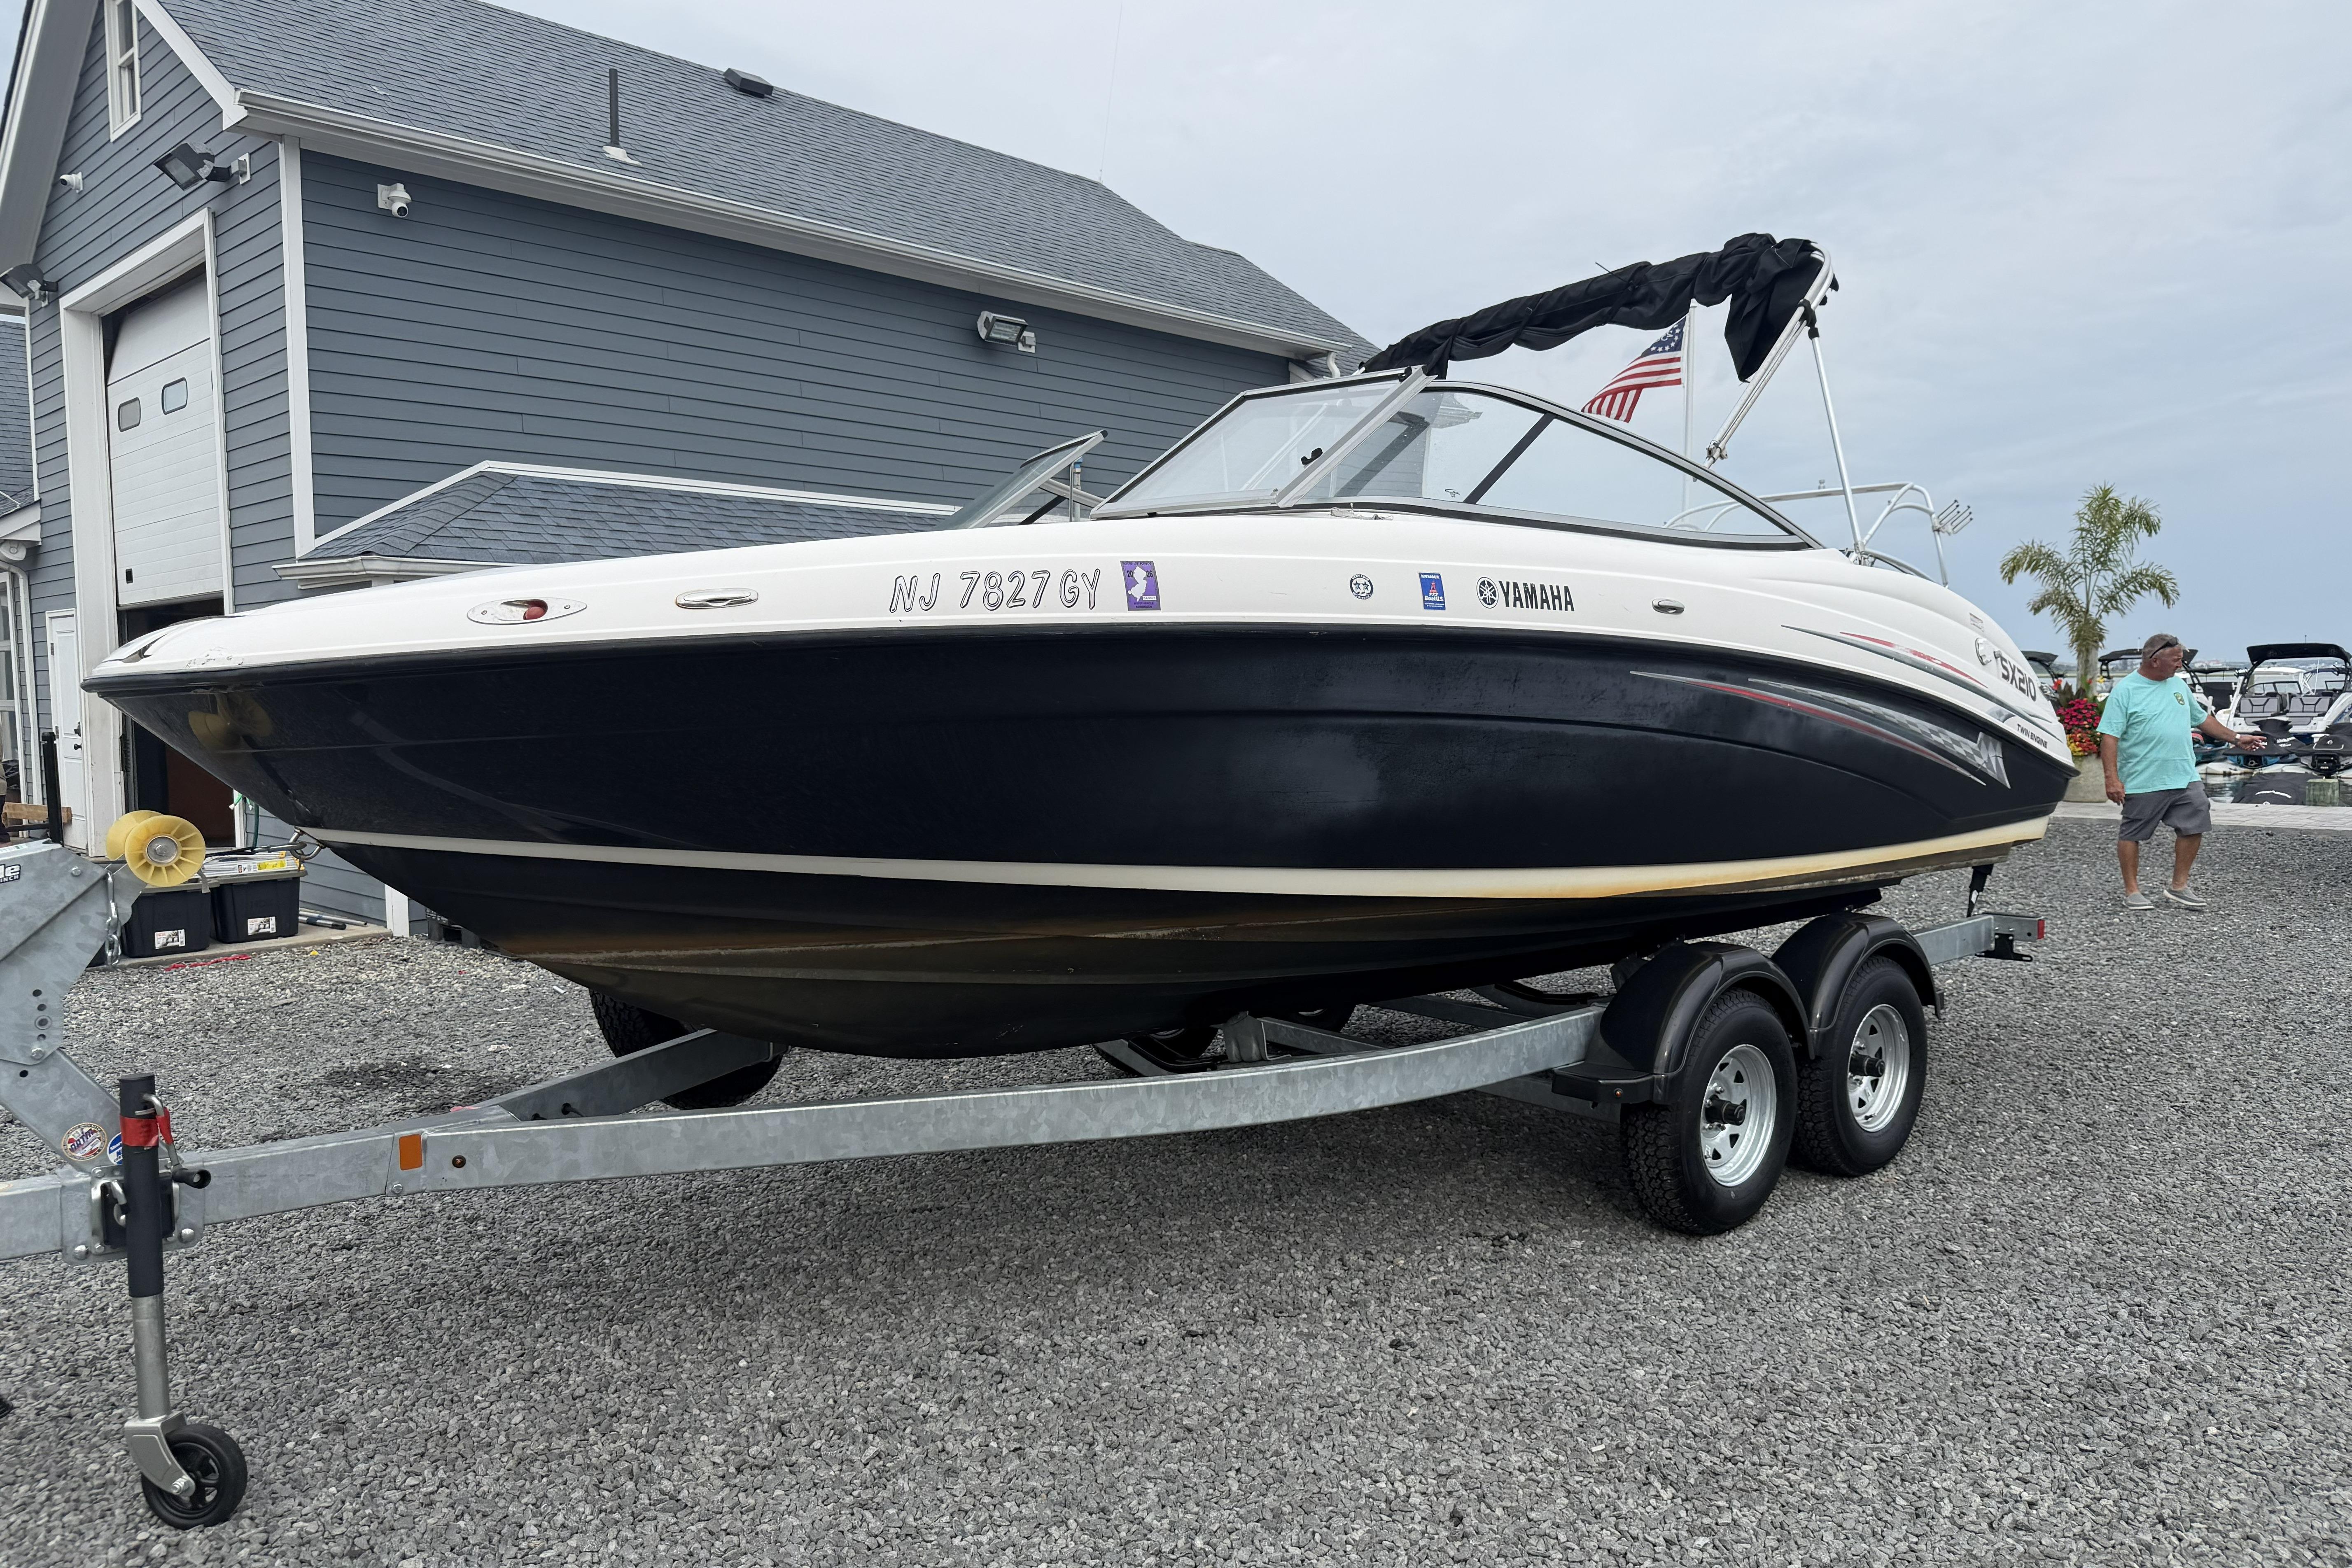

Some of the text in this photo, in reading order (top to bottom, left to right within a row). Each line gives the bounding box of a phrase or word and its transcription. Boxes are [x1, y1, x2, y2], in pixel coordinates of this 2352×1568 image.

[889, 568, 1100, 613] NJ 7827 GY
[1498, 581, 1575, 611] YAMAHA
[2000, 656, 2037, 702] SX210
[2017, 723, 2048, 749] TWIN ENGINE
